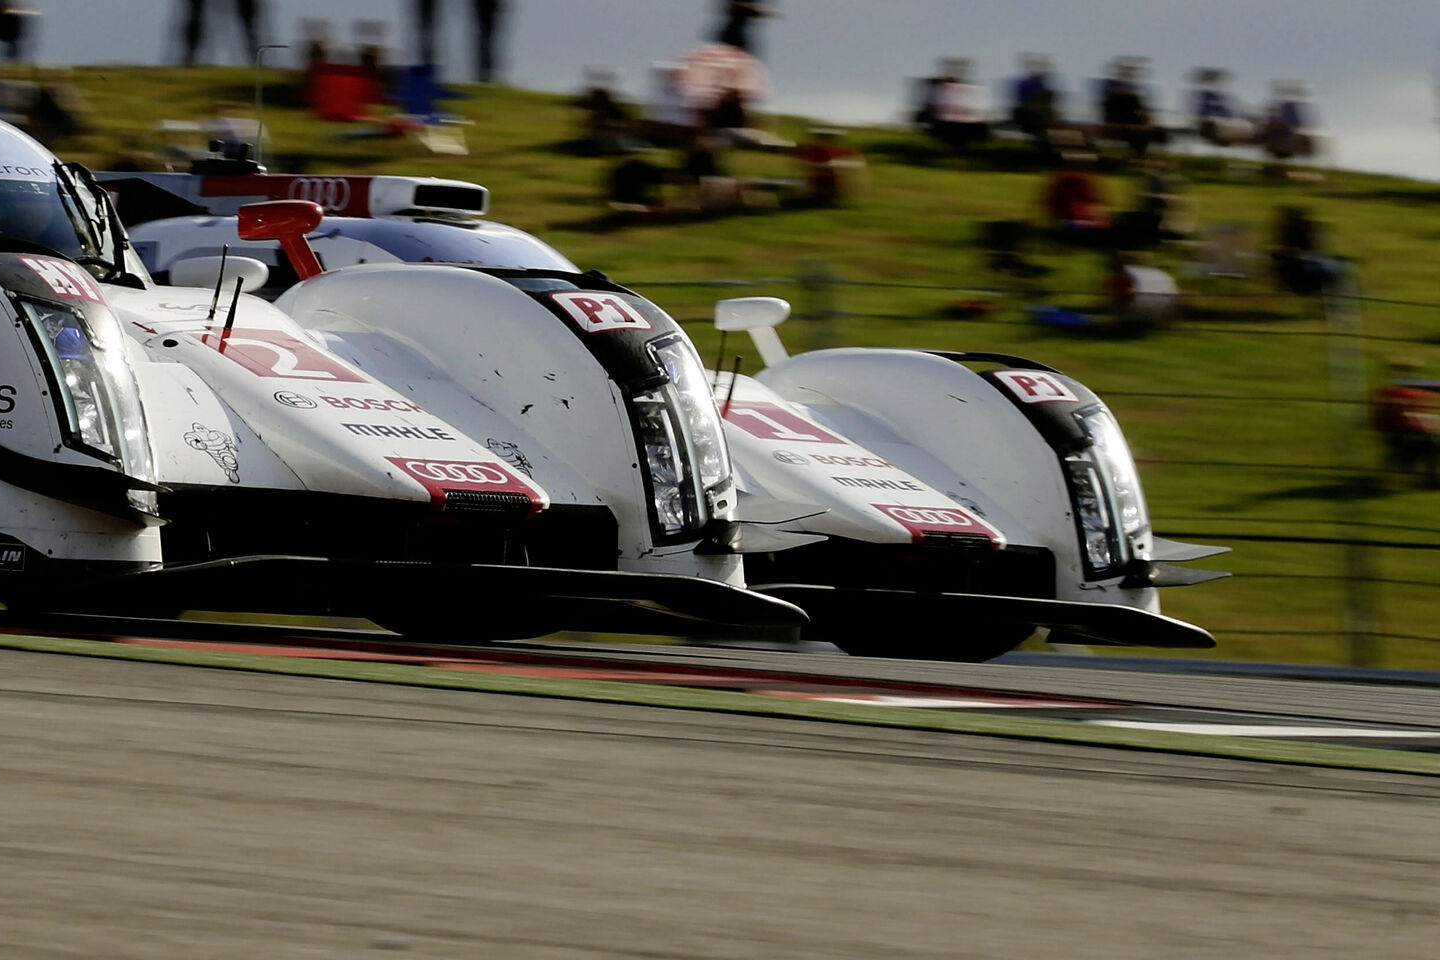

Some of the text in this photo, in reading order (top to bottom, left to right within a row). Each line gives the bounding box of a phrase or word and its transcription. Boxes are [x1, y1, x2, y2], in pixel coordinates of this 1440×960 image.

[569, 297, 636, 324] P1
[222, 337, 338, 379] 2
[1010, 375, 1065, 396] P1
[341, 423, 457, 441] MAHLE
[728, 408, 824, 441] 1
[829, 476, 925, 492] MAHLE
